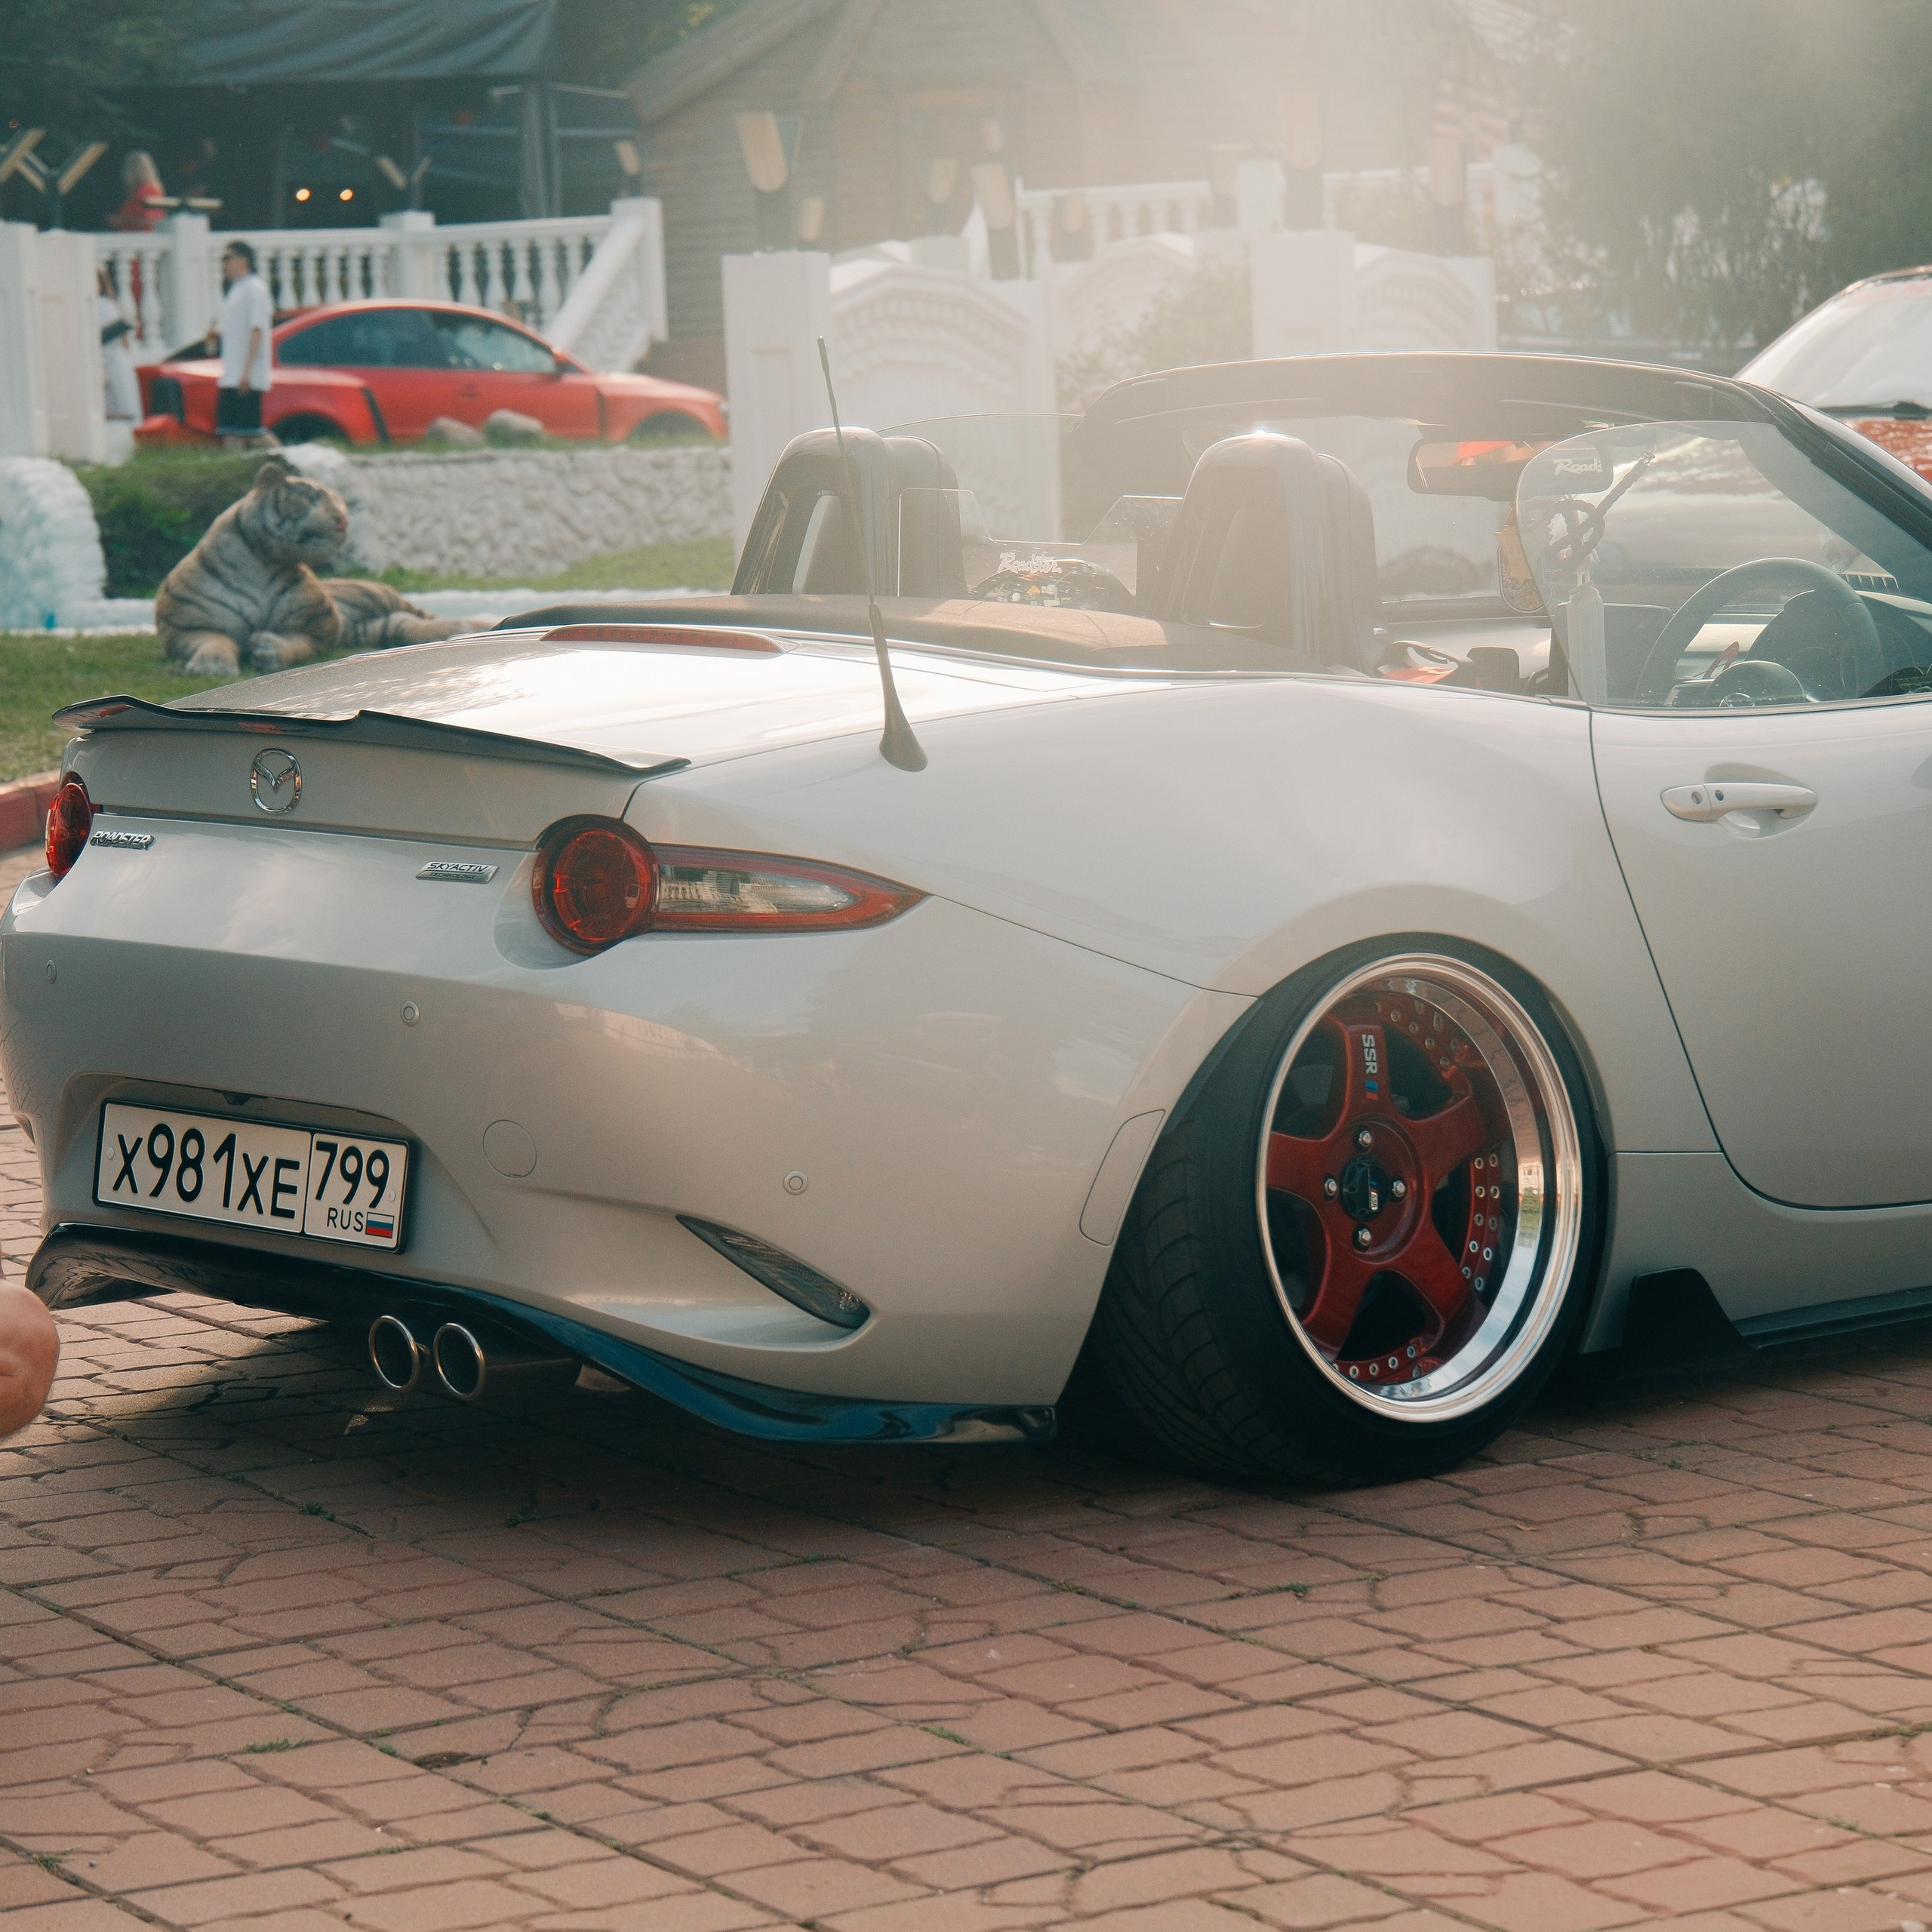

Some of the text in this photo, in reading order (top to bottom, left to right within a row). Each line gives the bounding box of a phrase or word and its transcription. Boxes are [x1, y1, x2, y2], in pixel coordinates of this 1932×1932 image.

[90, 831, 154, 850] ROADSTER
[427, 863, 488, 872] SKYACTIV
[429, 872, 476, 880] TECHNOLOGY
[1361, 1034, 1377, 1074] SSR
[315, 1140, 390, 1208] 799
[327, 1208, 364, 1232] RUS
